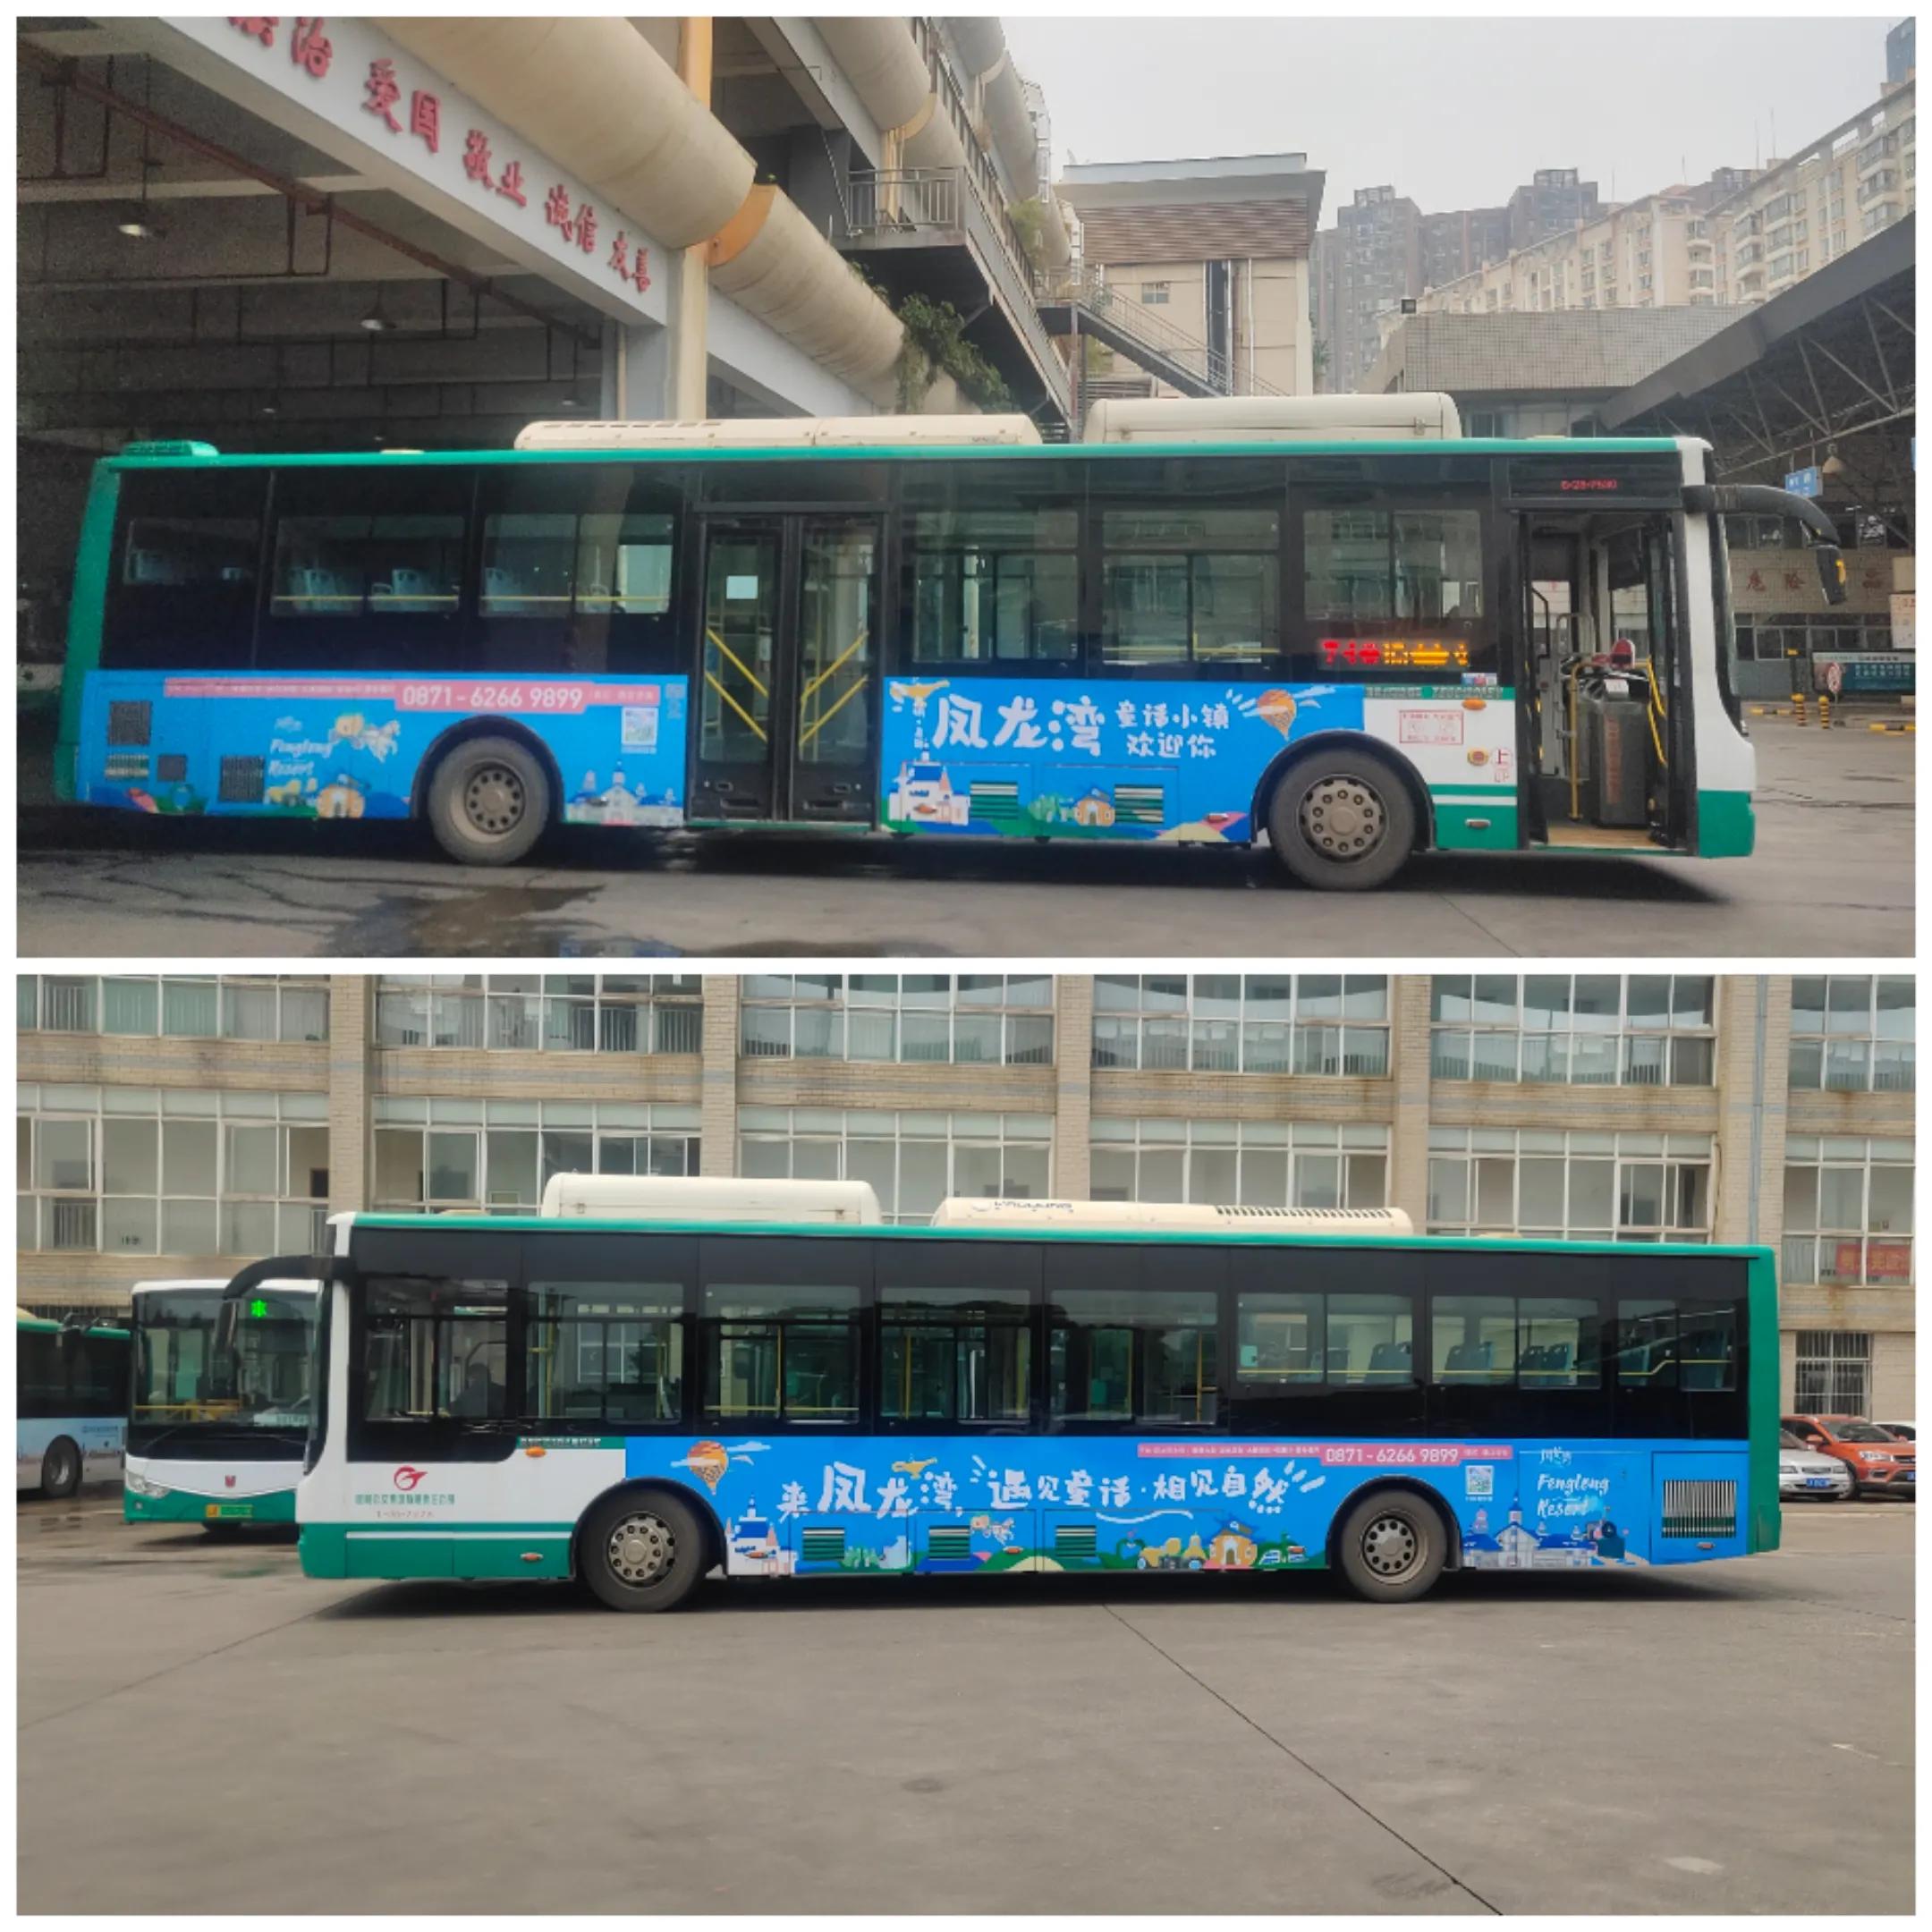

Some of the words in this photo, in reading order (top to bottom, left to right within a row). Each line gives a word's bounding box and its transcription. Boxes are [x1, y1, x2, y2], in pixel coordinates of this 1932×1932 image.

[361, 58, 439, 153] 爱国
[463, 130, 527, 207] 敬业
[546, 184, 597, 252] 诚信
[608, 231, 651, 292] 友善
[530, 688, 583, 709] 9899
[932, 693, 1106, 757] 凤龙湾
[1115, 699, 1230, 730] 童话小镇
[1126, 731, 1217, 758] 欢迎你
[1420, 1448, 1459, 1464] 9899
